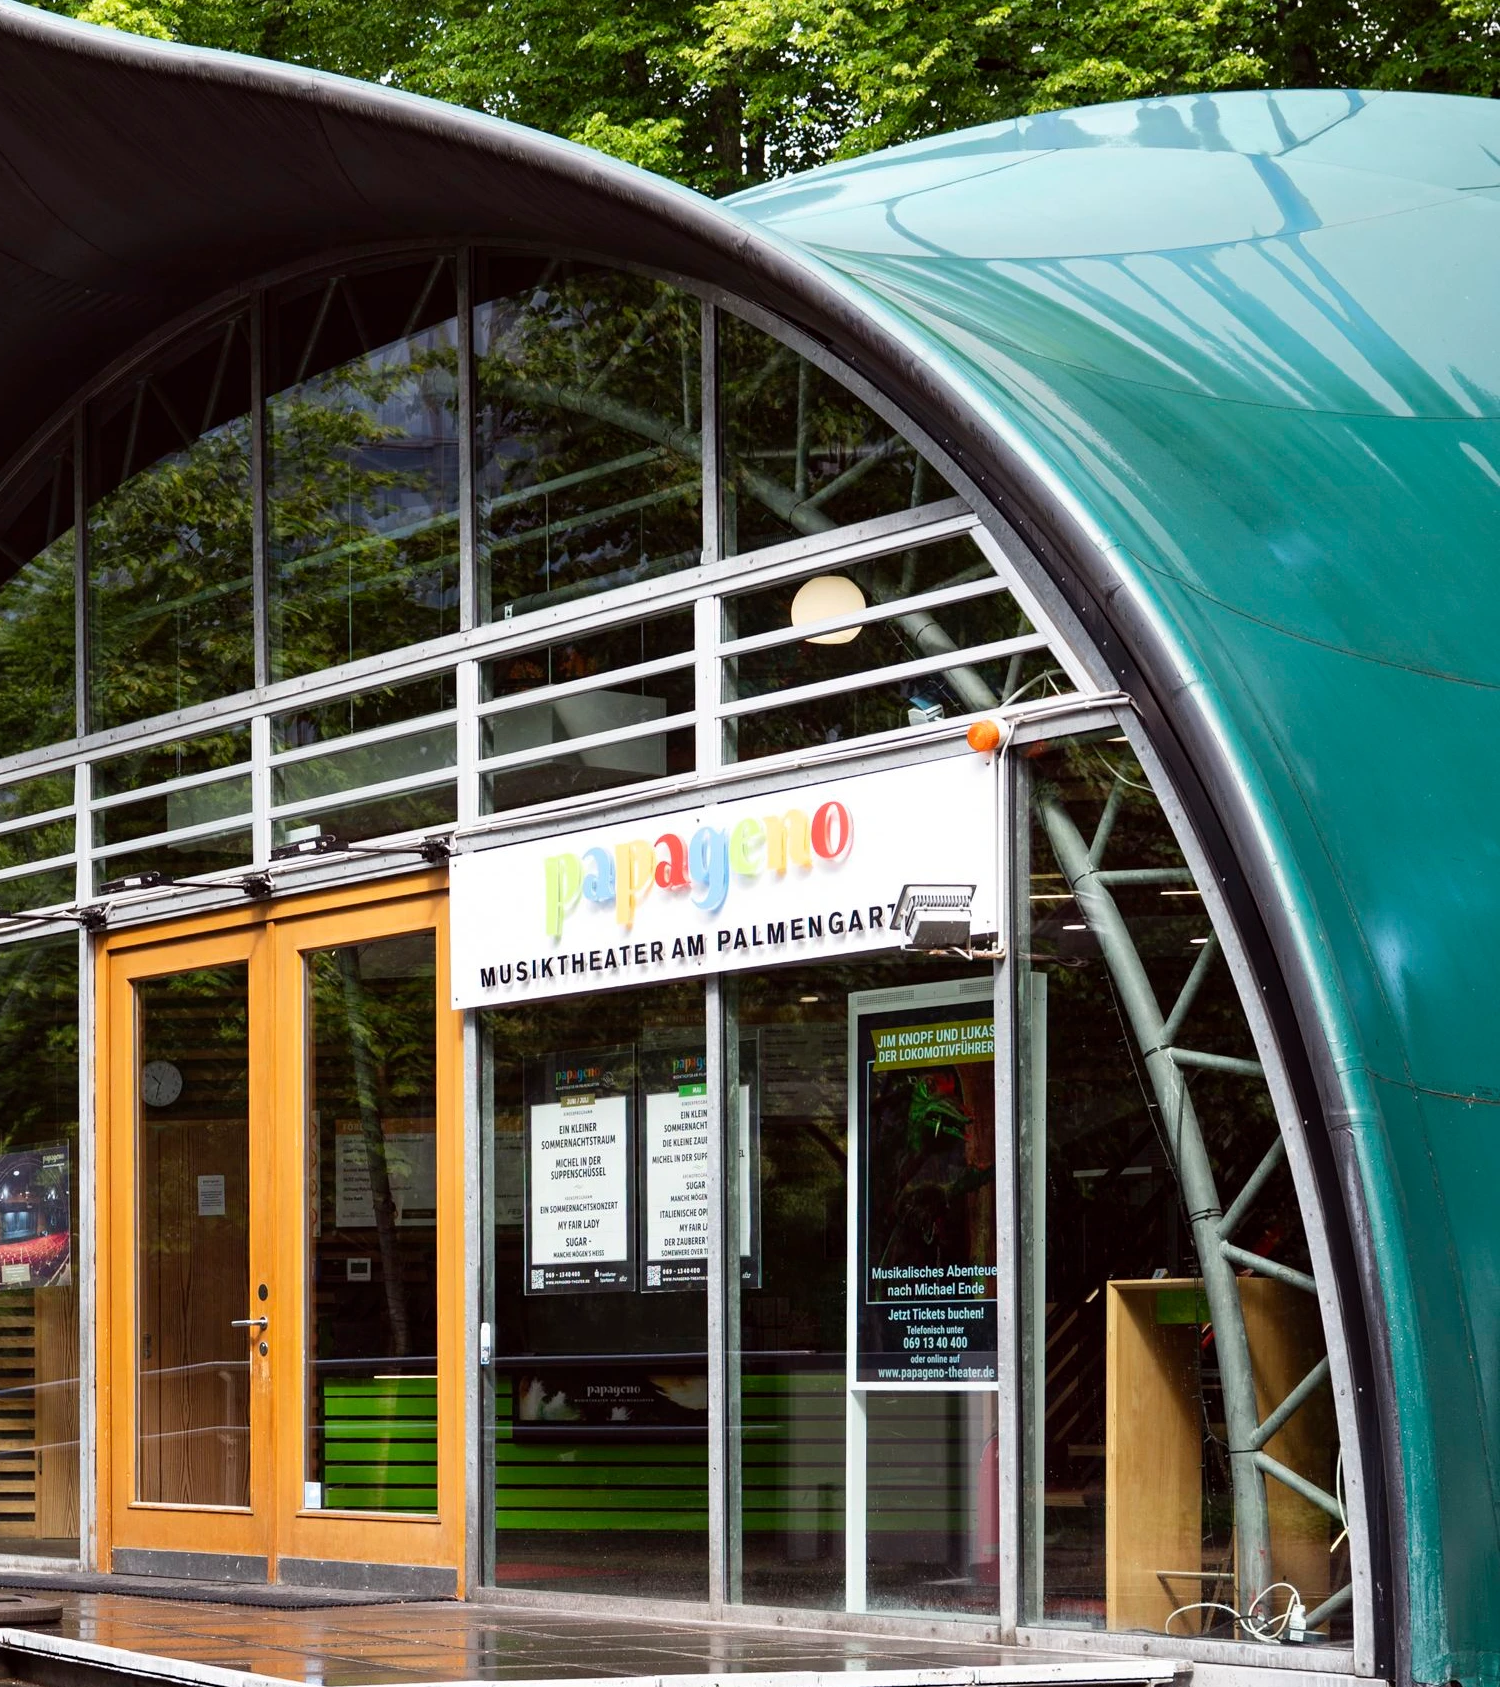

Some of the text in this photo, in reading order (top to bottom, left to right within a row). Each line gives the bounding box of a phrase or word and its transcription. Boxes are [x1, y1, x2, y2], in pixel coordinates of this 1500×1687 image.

[544, 801, 855, 940] papageno
[480, 941, 663, 988] MUSIKTHEATER
[671, 934, 705, 959] AM
[877, 1024, 995, 1049] JIM KNOPF UND LUKAS
[879, 1041, 994, 1063] DER LOKOMOTIVFÜHRER
[680, 1109, 708, 1120] EIN KLEIN
[559, 1122, 597, 1135] EIN KLEINER
[664, 1121, 708, 1133] SOMMERNACHT
[541, 1134, 616, 1150] SOMMERNACHTSTRAUM
[662, 1138, 672, 1148] DIE
[673, 1137, 692, 1147] KLEINE
[555, 1155, 601, 1168] MICHEL IN DER
[652, 1154, 673, 1164] MICHEL
[674, 1153, 681, 1162] IN
[681, 1152, 692, 1162] DER
[550, 1166, 606, 1180] SUPPENSCHÜSSEL
[686, 1181, 706, 1190] SUGAR
[690, 1192, 708, 1201] MÖGEN
[540, 1201, 618, 1215] EIN SOMMERNACHTSKONZERT
[659, 1208, 697, 1219] ITALIENISCHE
[557, 1219, 600, 1231] MY FAIR LADY
[679, 1224, 688, 1232] MY
[689, 1223, 701, 1231] FAIR
[565, 1237, 587, 1247] SUGAR
[664, 1238, 676, 1247] DER
[677, 1236, 706, 1246] ZAUBERER
[592, 1249, 605, 1257] HEISS
[661, 1249, 690, 1257] SOMEWHERE
[872, 1264, 997, 1280] Musikalisches Abenteue
[887, 1281, 985, 1297] nach Michael Ende
[888, 1307, 984, 1321] Jetzt Tickets buchen!
[906, 1325, 965, 1335] Telefonisch unter
[903, 1336, 968, 1349] 069 13 40 400
[910, 1354, 960, 1364] oder online auf
[878, 1365, 995, 1381] www.papageno-theater.de
[587, 1385, 641, 1397] papageno
